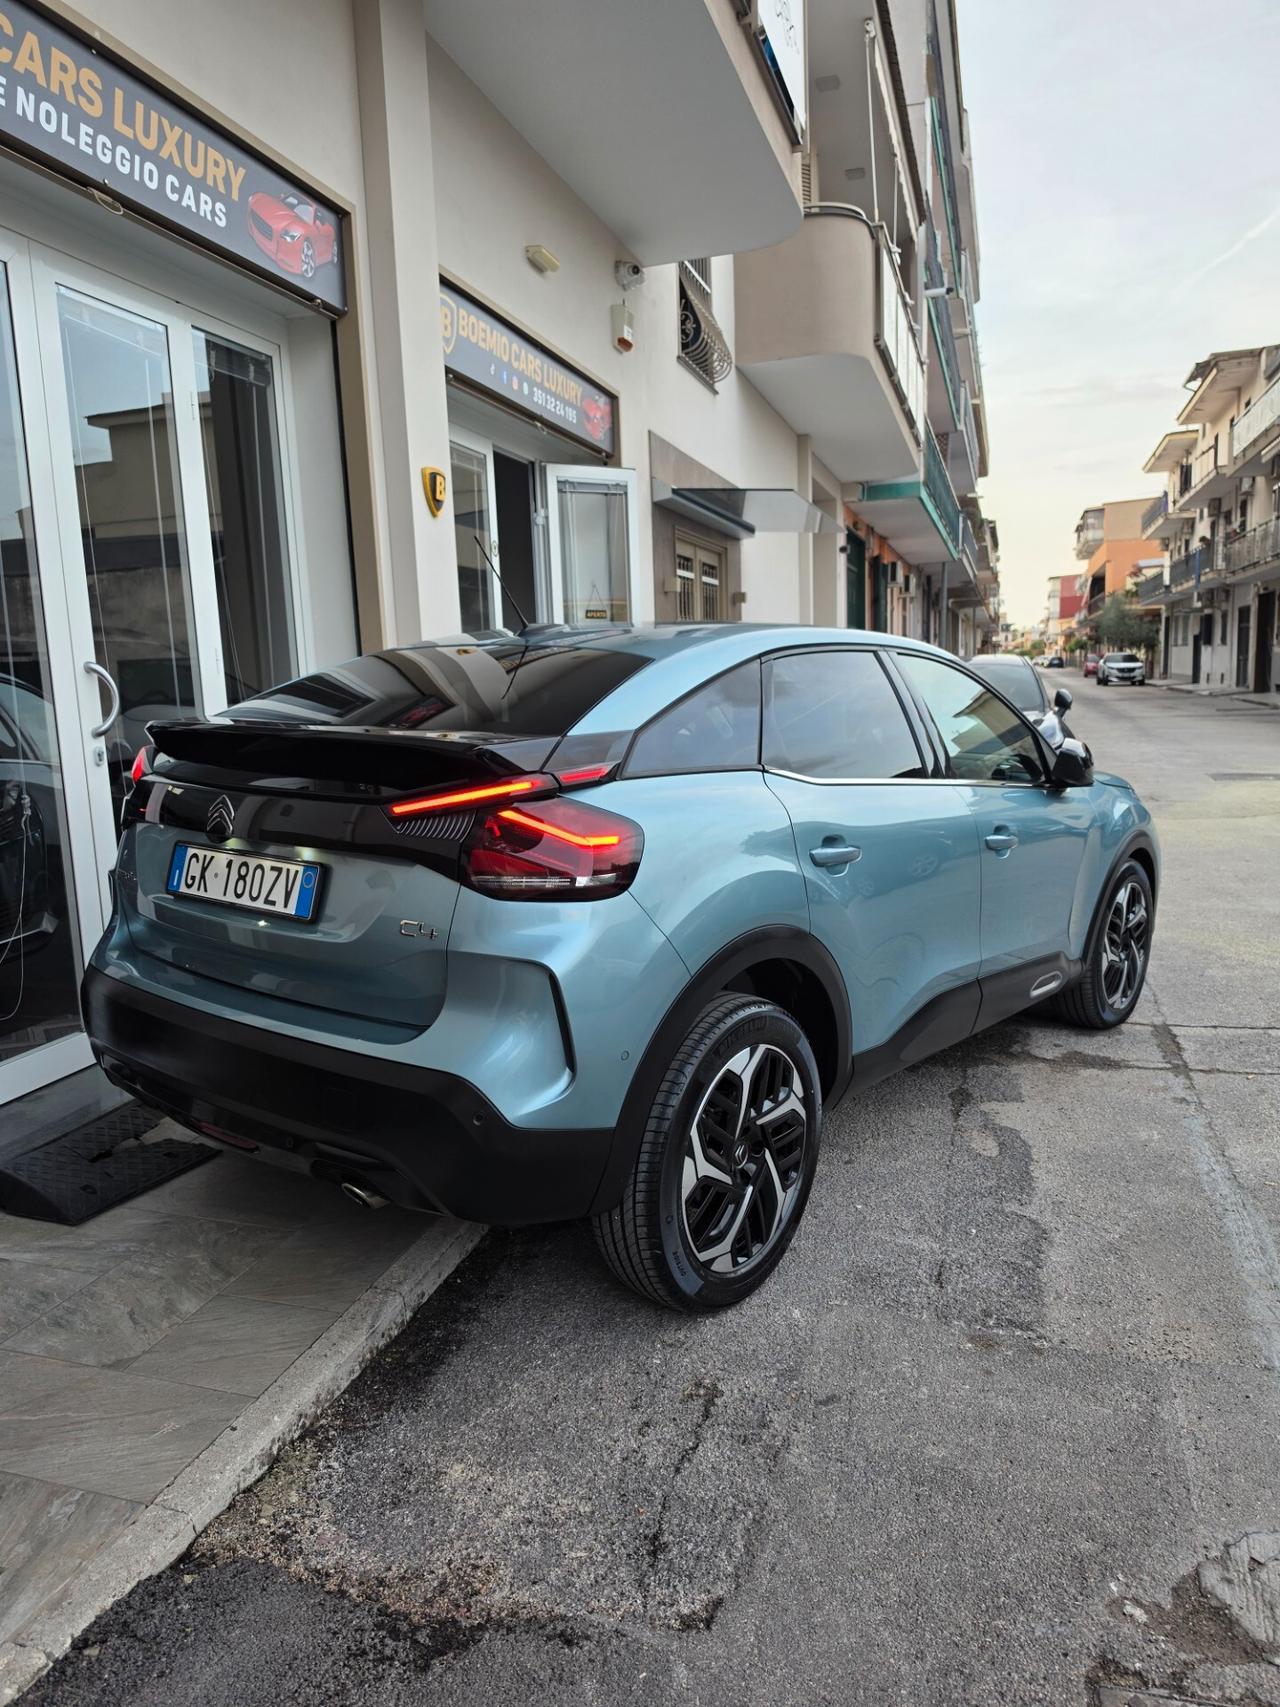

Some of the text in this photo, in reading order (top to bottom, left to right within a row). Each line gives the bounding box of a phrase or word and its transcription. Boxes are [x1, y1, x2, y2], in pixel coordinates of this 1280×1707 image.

[16, 85, 159, 190] NOLEGGIO
[165, 174, 227, 228] CARS
[113, 87, 246, 202] LUXURY
[458, 308, 582, 407] BOEMIO CARS LUXURY
[436, 474, 445, 500] B
[184, 852, 300, 909] GK 180ZV
[399, 919, 439, 940] C4
